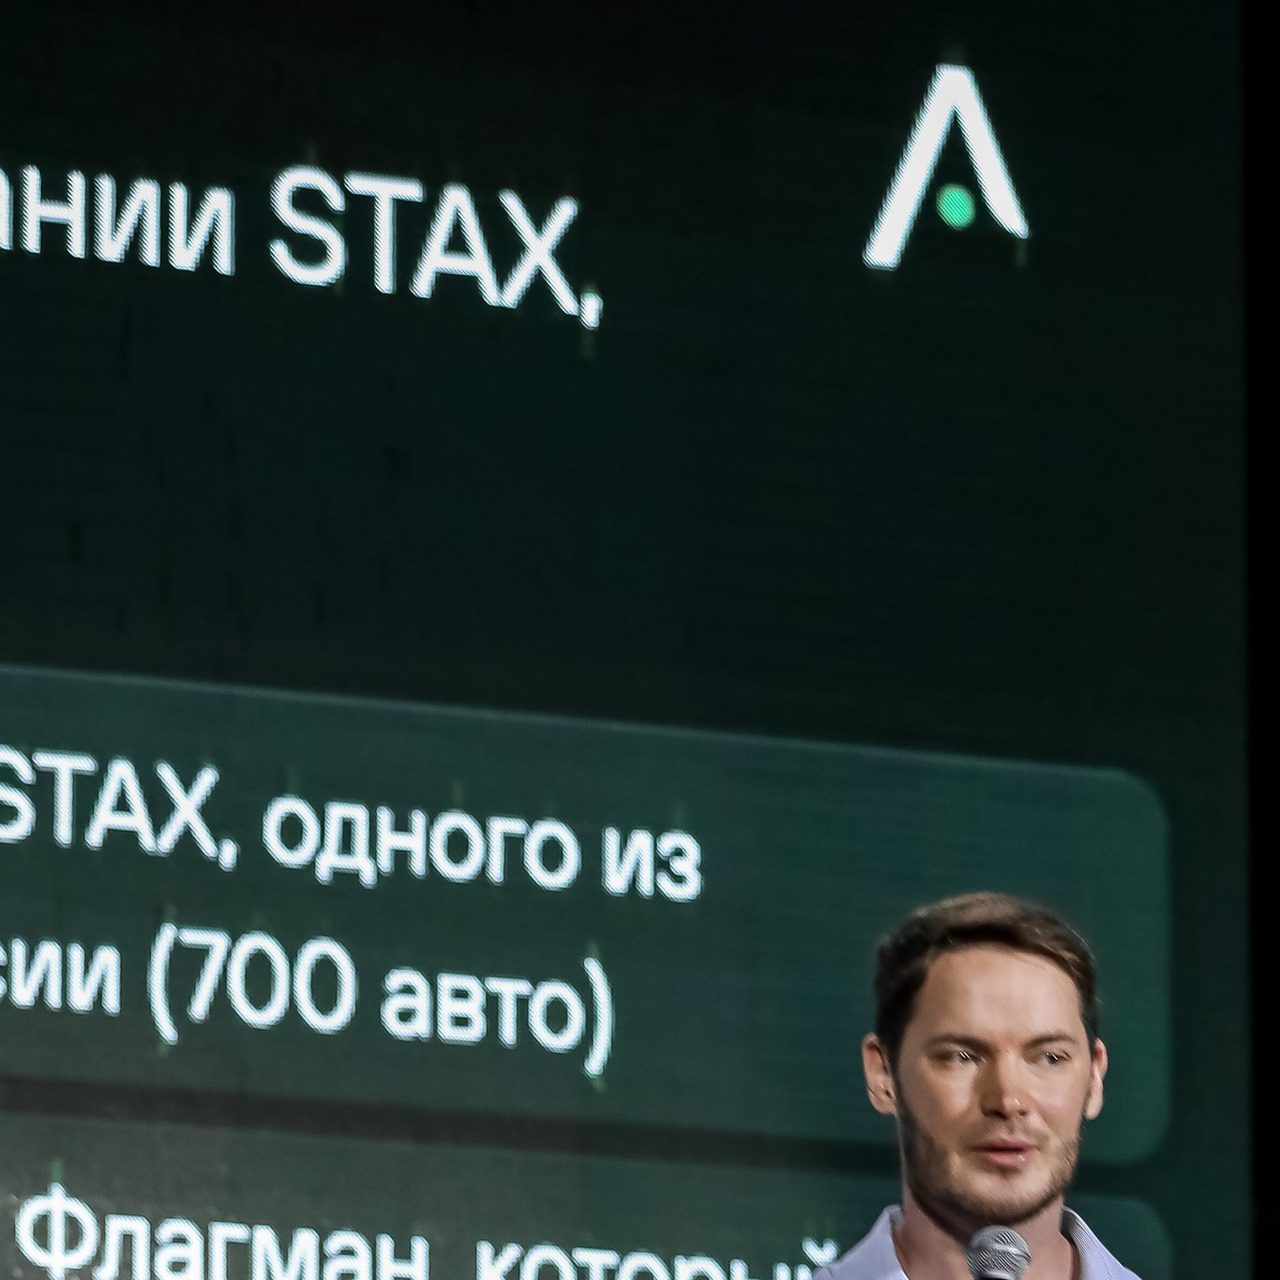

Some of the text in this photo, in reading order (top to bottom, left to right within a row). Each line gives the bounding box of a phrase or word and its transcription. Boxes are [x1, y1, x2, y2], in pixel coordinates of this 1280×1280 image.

[0, 164, 604, 329] нии STAX,
[0, 744, 703, 902] STAX, одного из
[0, 922, 613, 1076] ии (700 авто)
